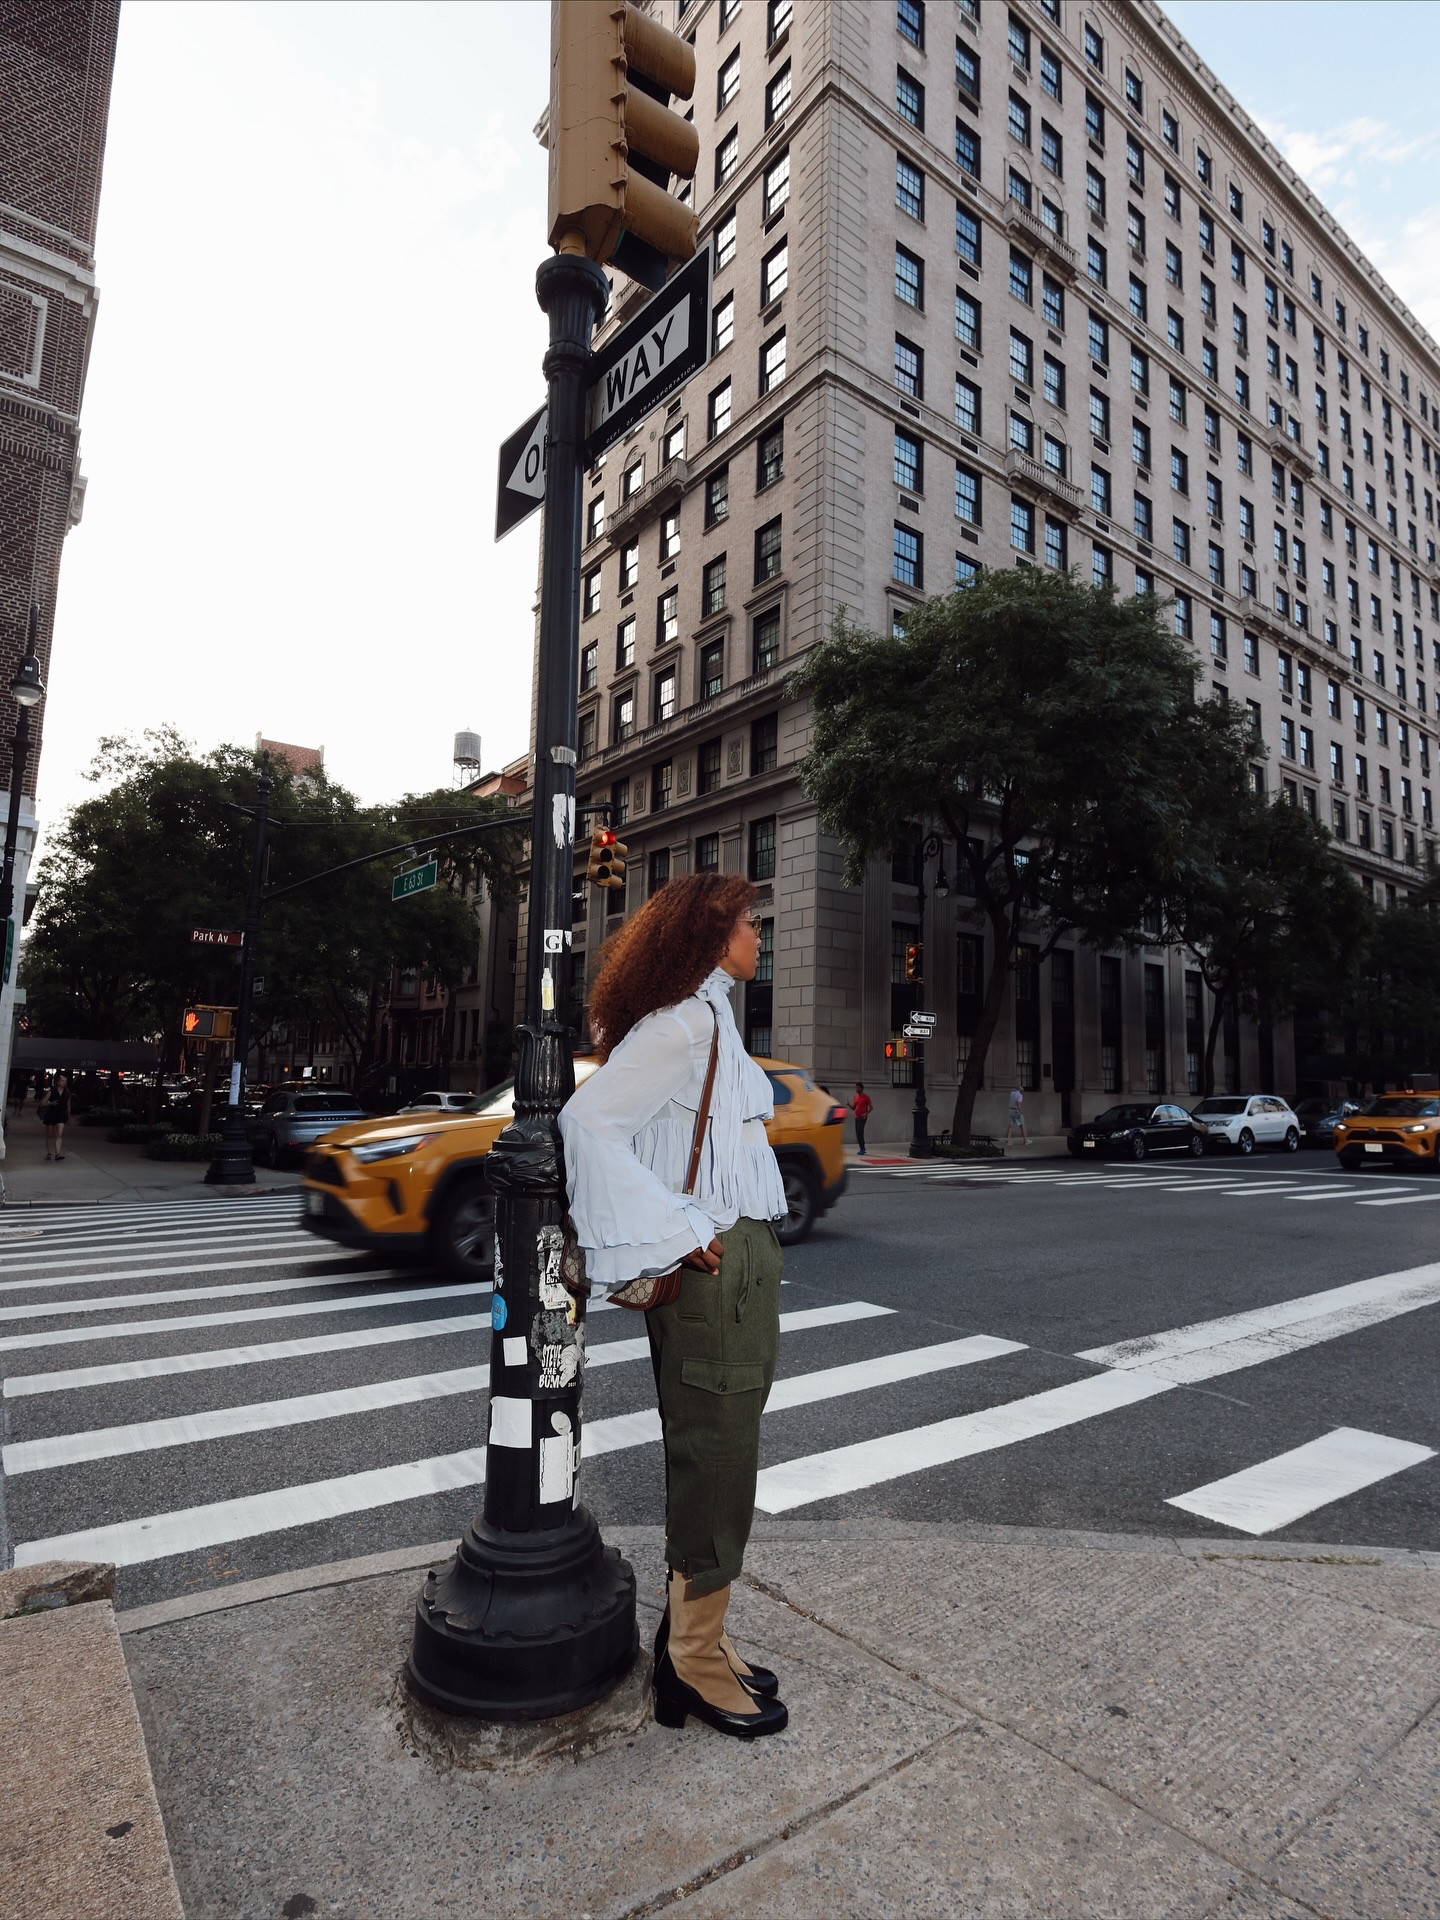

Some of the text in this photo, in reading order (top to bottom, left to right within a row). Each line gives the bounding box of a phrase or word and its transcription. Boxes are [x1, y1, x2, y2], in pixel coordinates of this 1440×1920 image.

[606, 314, 674, 413] WAY
[639, 362, 697, 414] TRANSPORTATION
[193, 930, 229, 943] Park Av
[545, 934, 560, 950] G
[542, 1367, 557, 1375] THE
[538, 1374, 560, 1389] BUM
